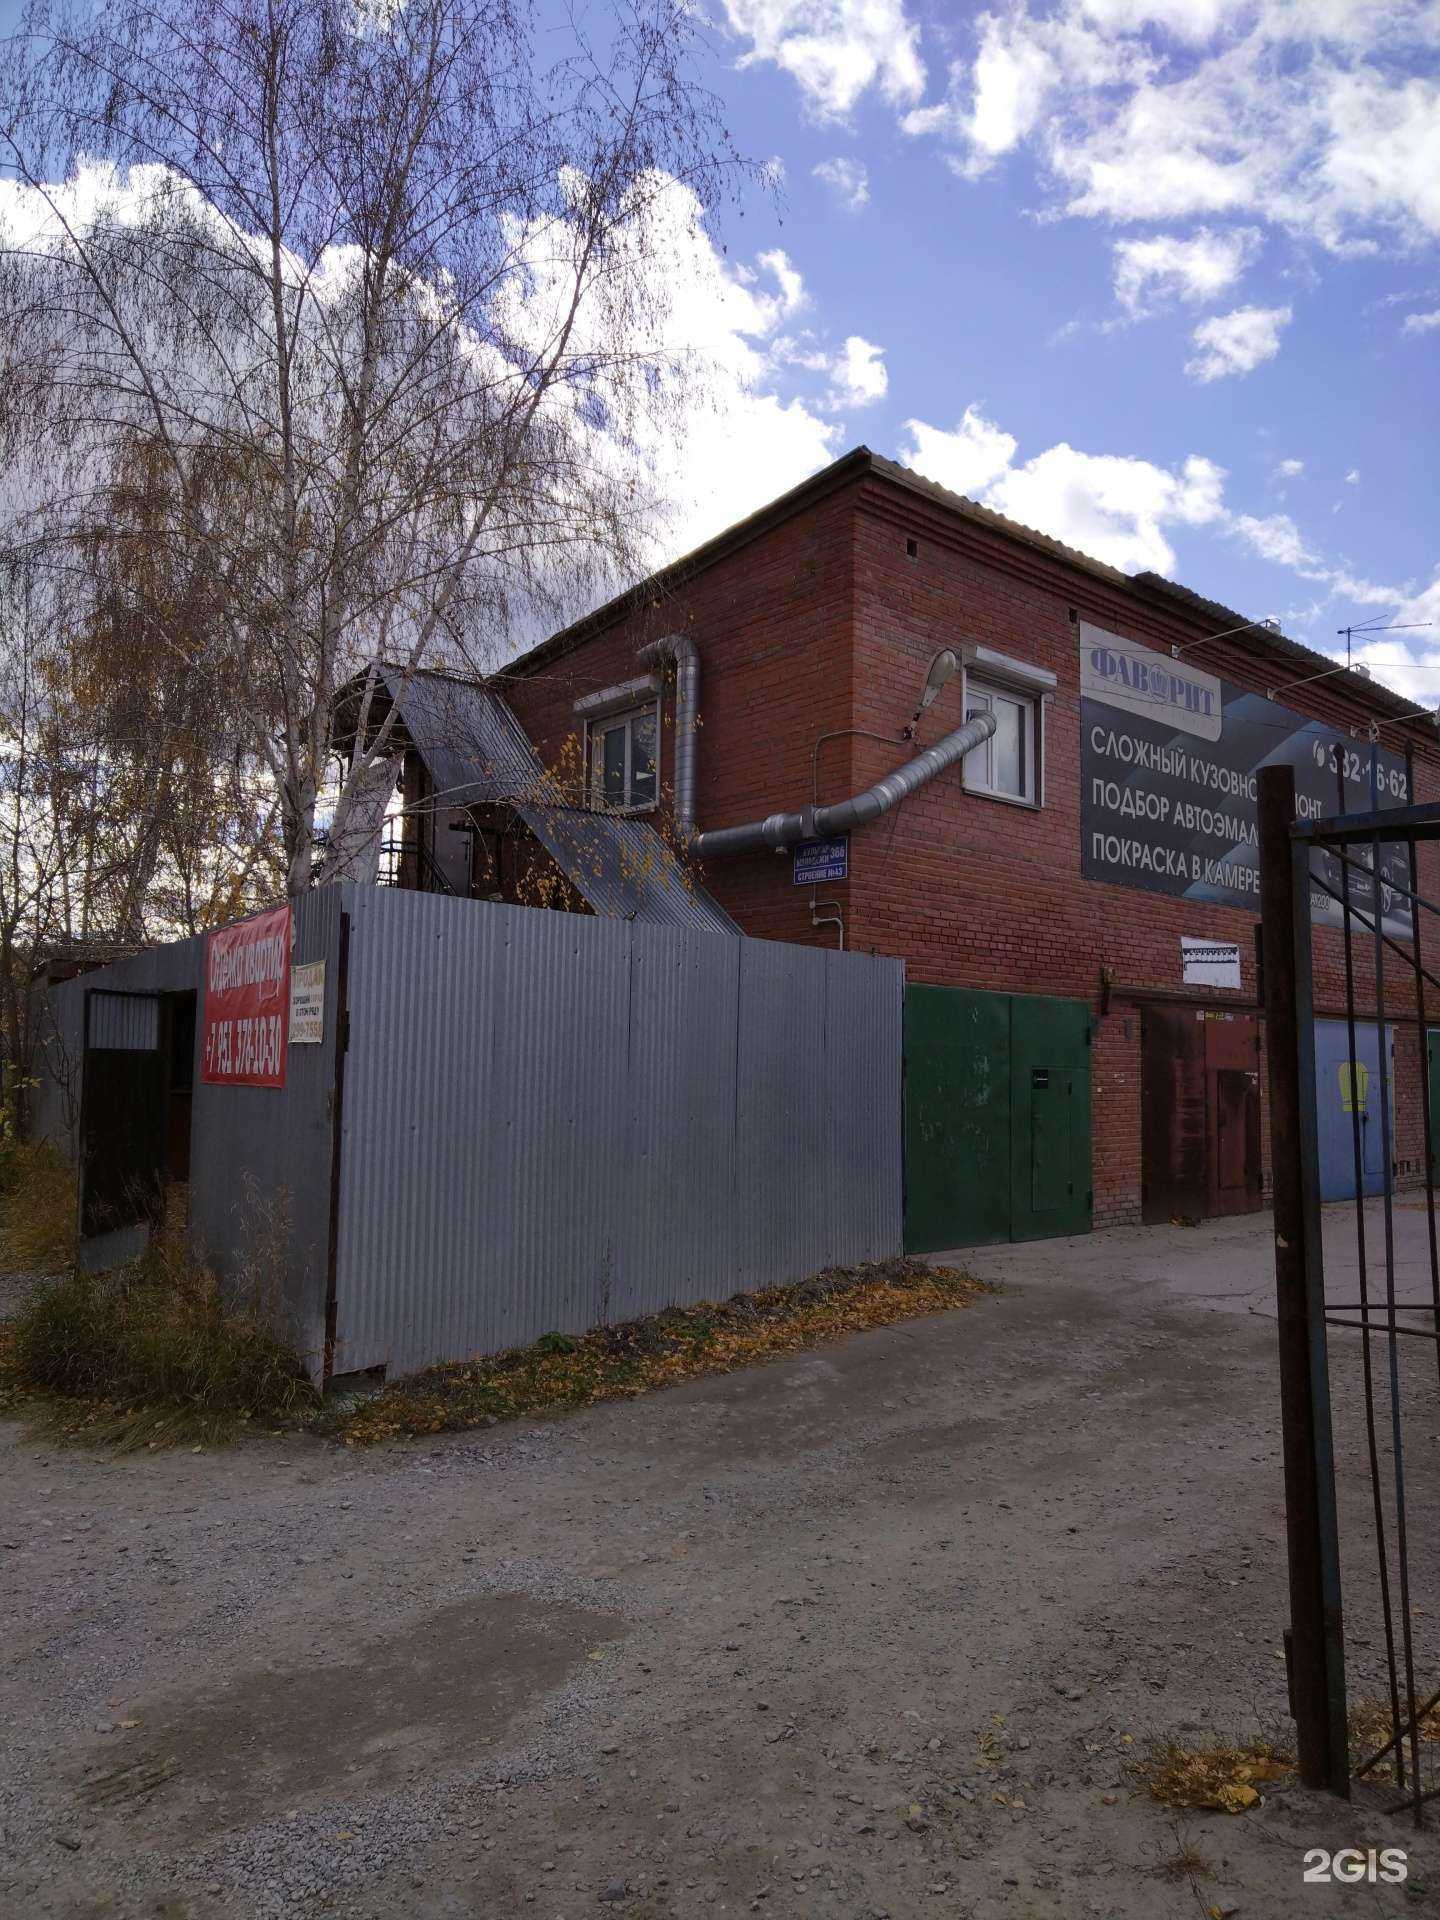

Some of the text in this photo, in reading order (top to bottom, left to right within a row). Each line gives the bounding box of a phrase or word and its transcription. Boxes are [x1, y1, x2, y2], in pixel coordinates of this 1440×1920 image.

[1091, 726, 1187, 779] СЛОЖНЫЙ
[1092, 777, 1170, 822] ПОДБОР
[1092, 832, 1261, 894] ПОКРАСКА В КАМЕРЕ
